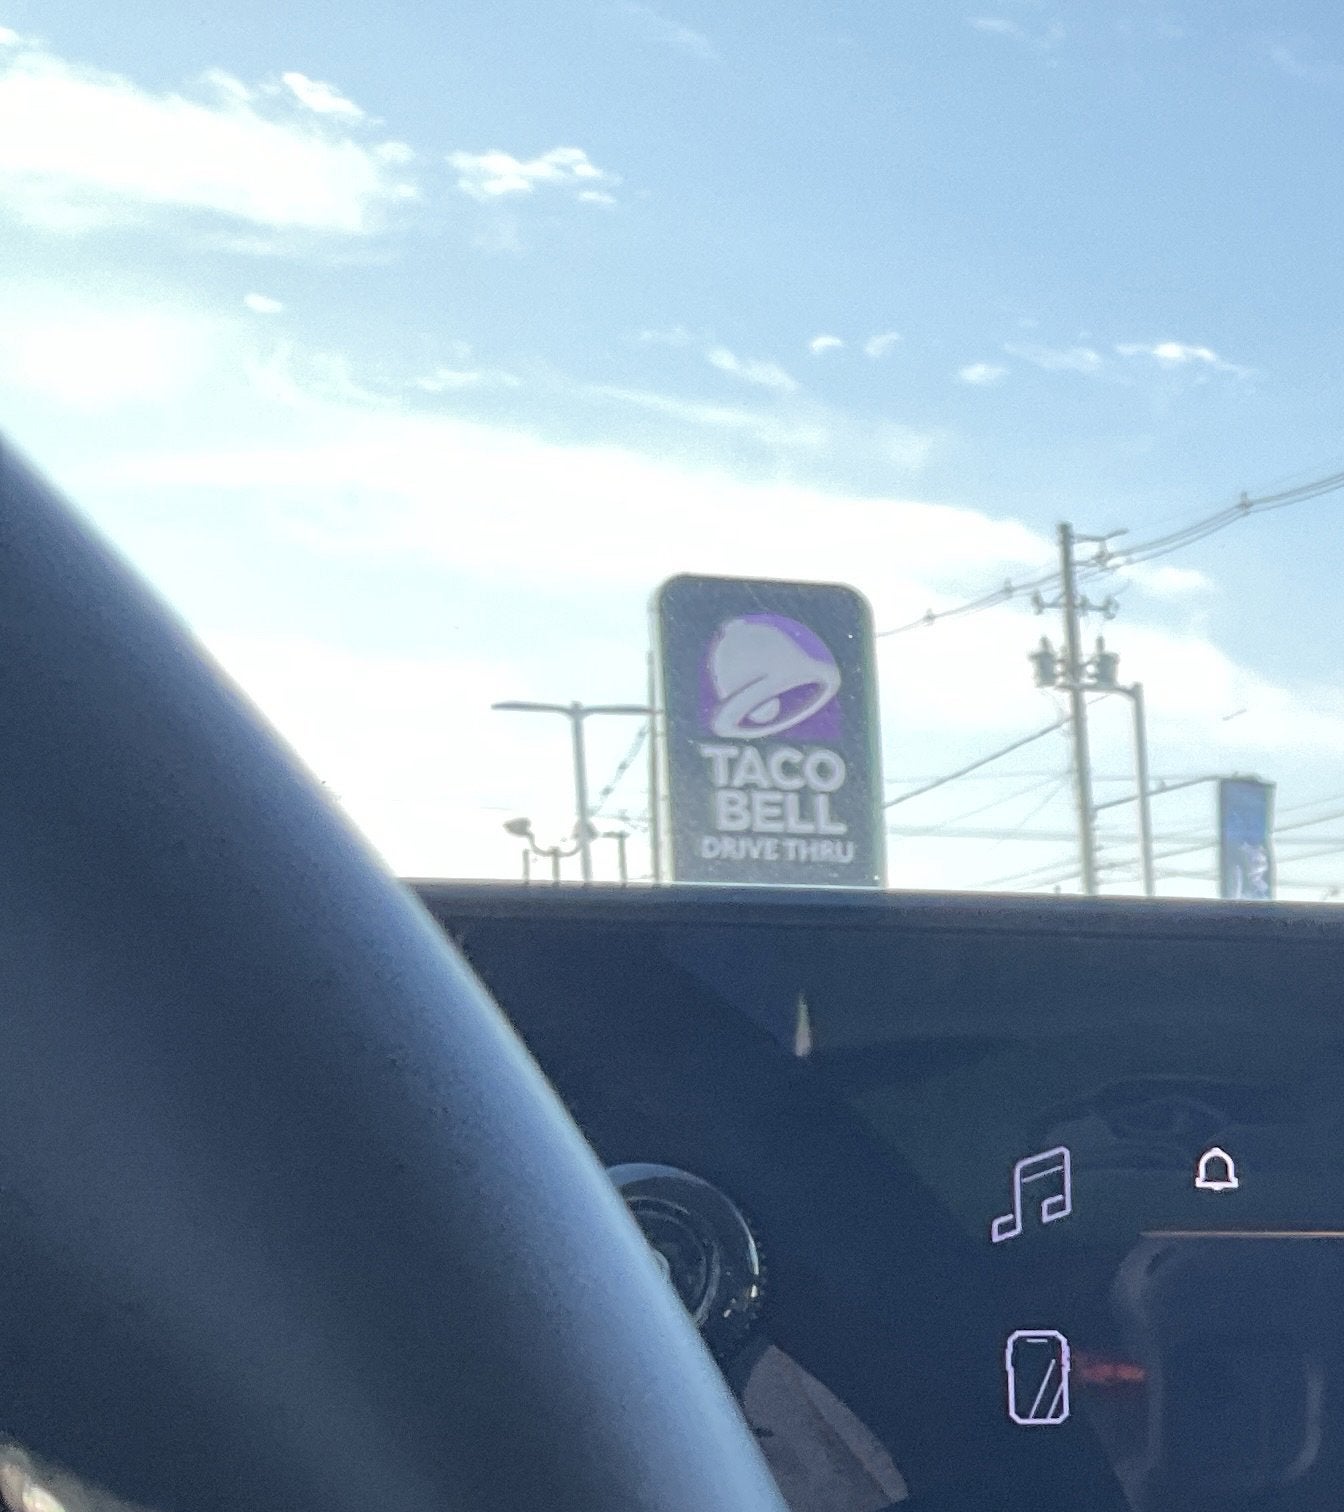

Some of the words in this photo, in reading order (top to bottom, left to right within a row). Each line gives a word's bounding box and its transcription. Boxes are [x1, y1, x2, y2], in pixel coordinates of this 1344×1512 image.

[701, 744, 846, 791] TACO
[716, 789, 848, 834] BELL
[700, 835, 780, 861] DRIVE
[782, 837, 855, 863] THRU
